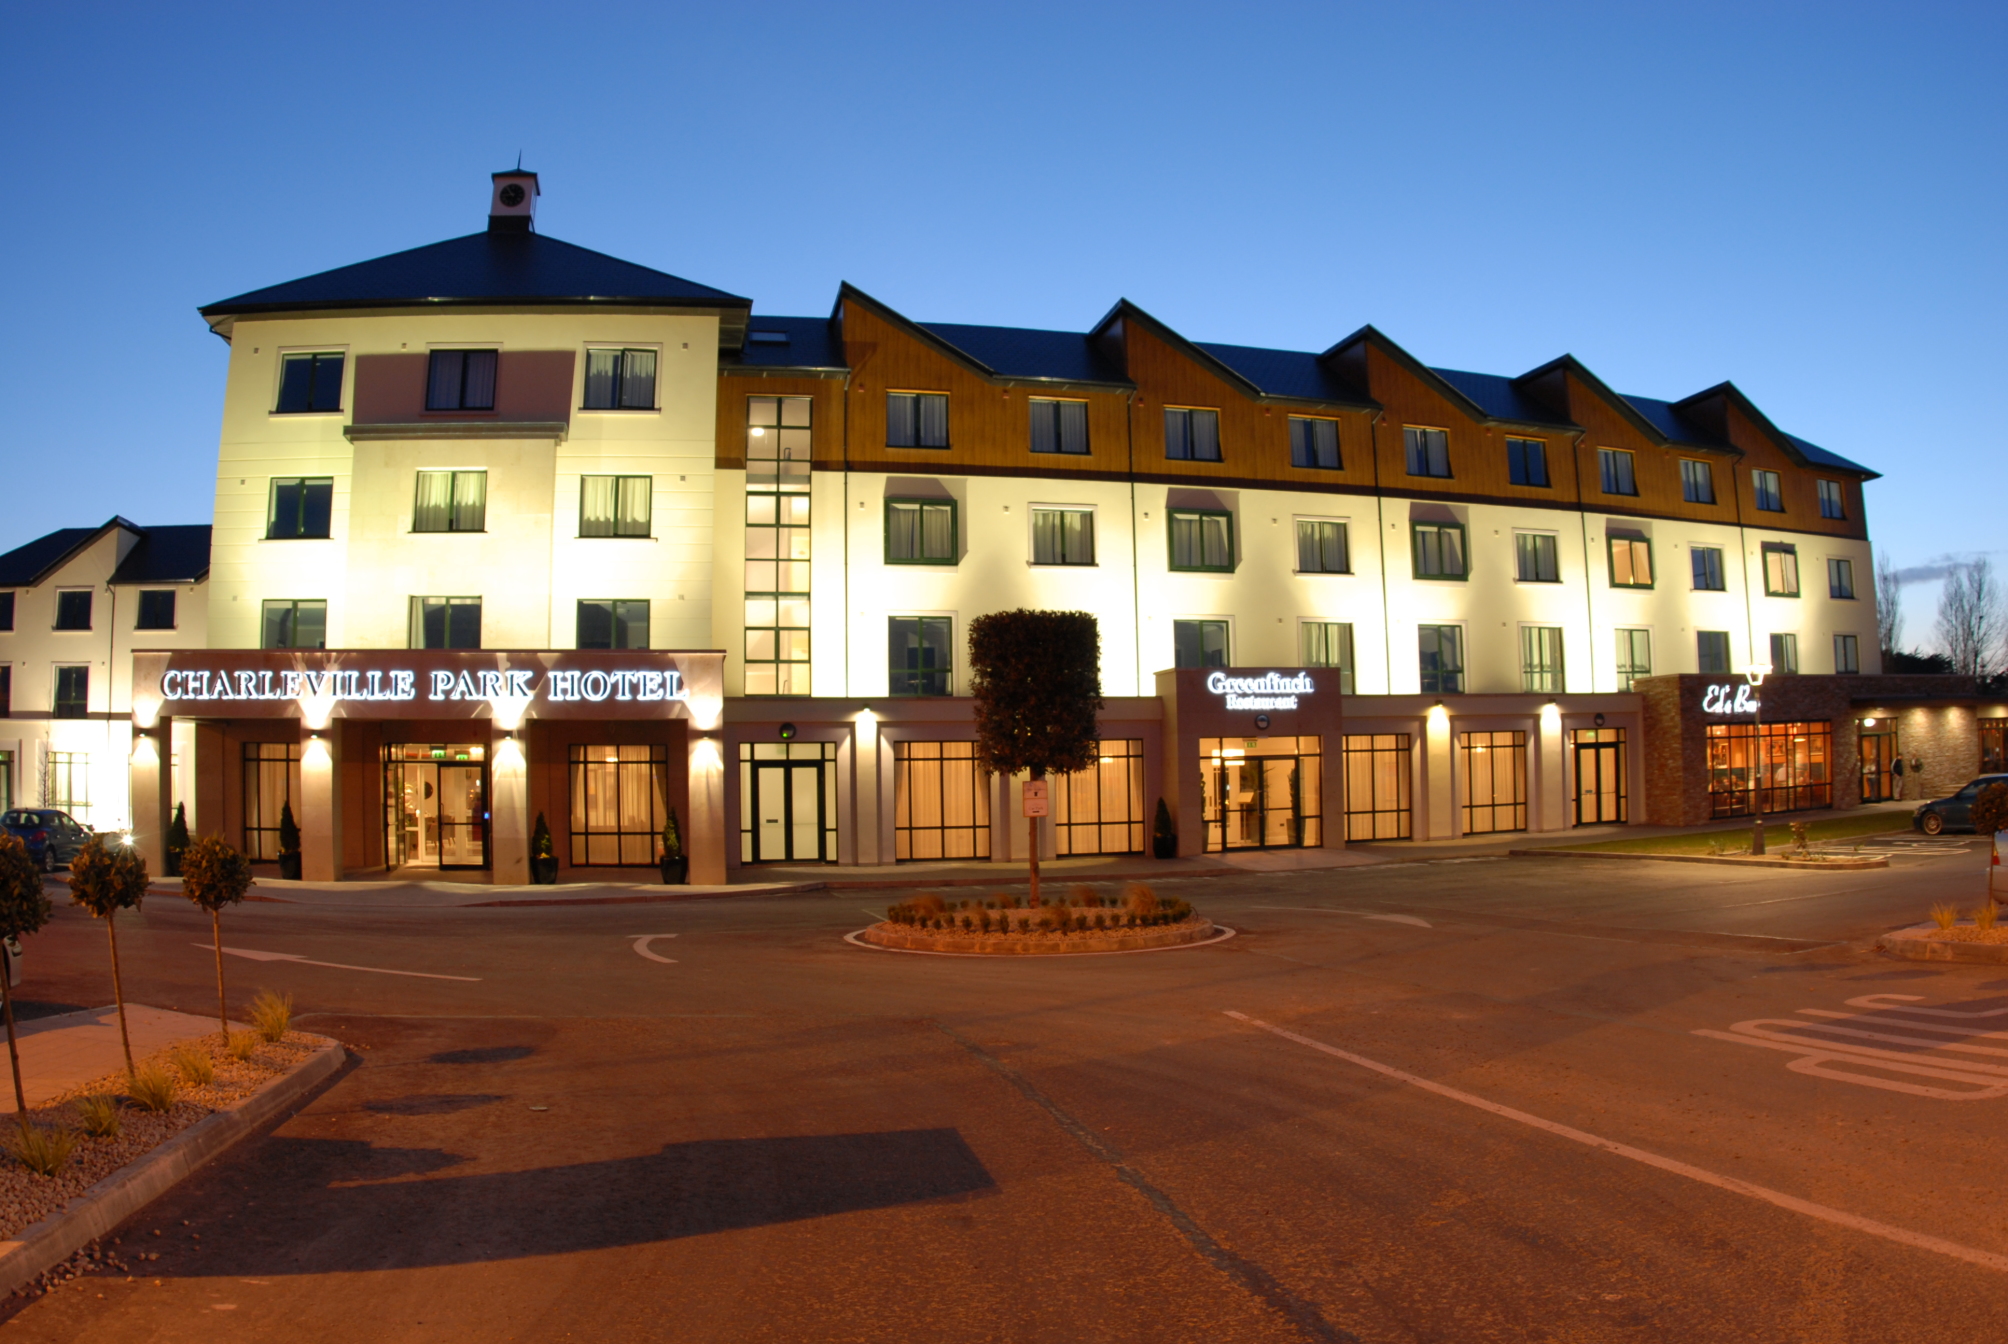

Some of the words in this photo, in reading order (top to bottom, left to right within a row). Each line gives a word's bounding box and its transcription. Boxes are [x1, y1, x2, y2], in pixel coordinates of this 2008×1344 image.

[160, 670, 416, 700] CHARLEVILLE
[428, 670, 534, 701] PARK
[547, 670, 690, 701] HOTEL
[1207, 671, 1315, 694] Greenfinch
[1225, 693, 1299, 710] Restaurant
